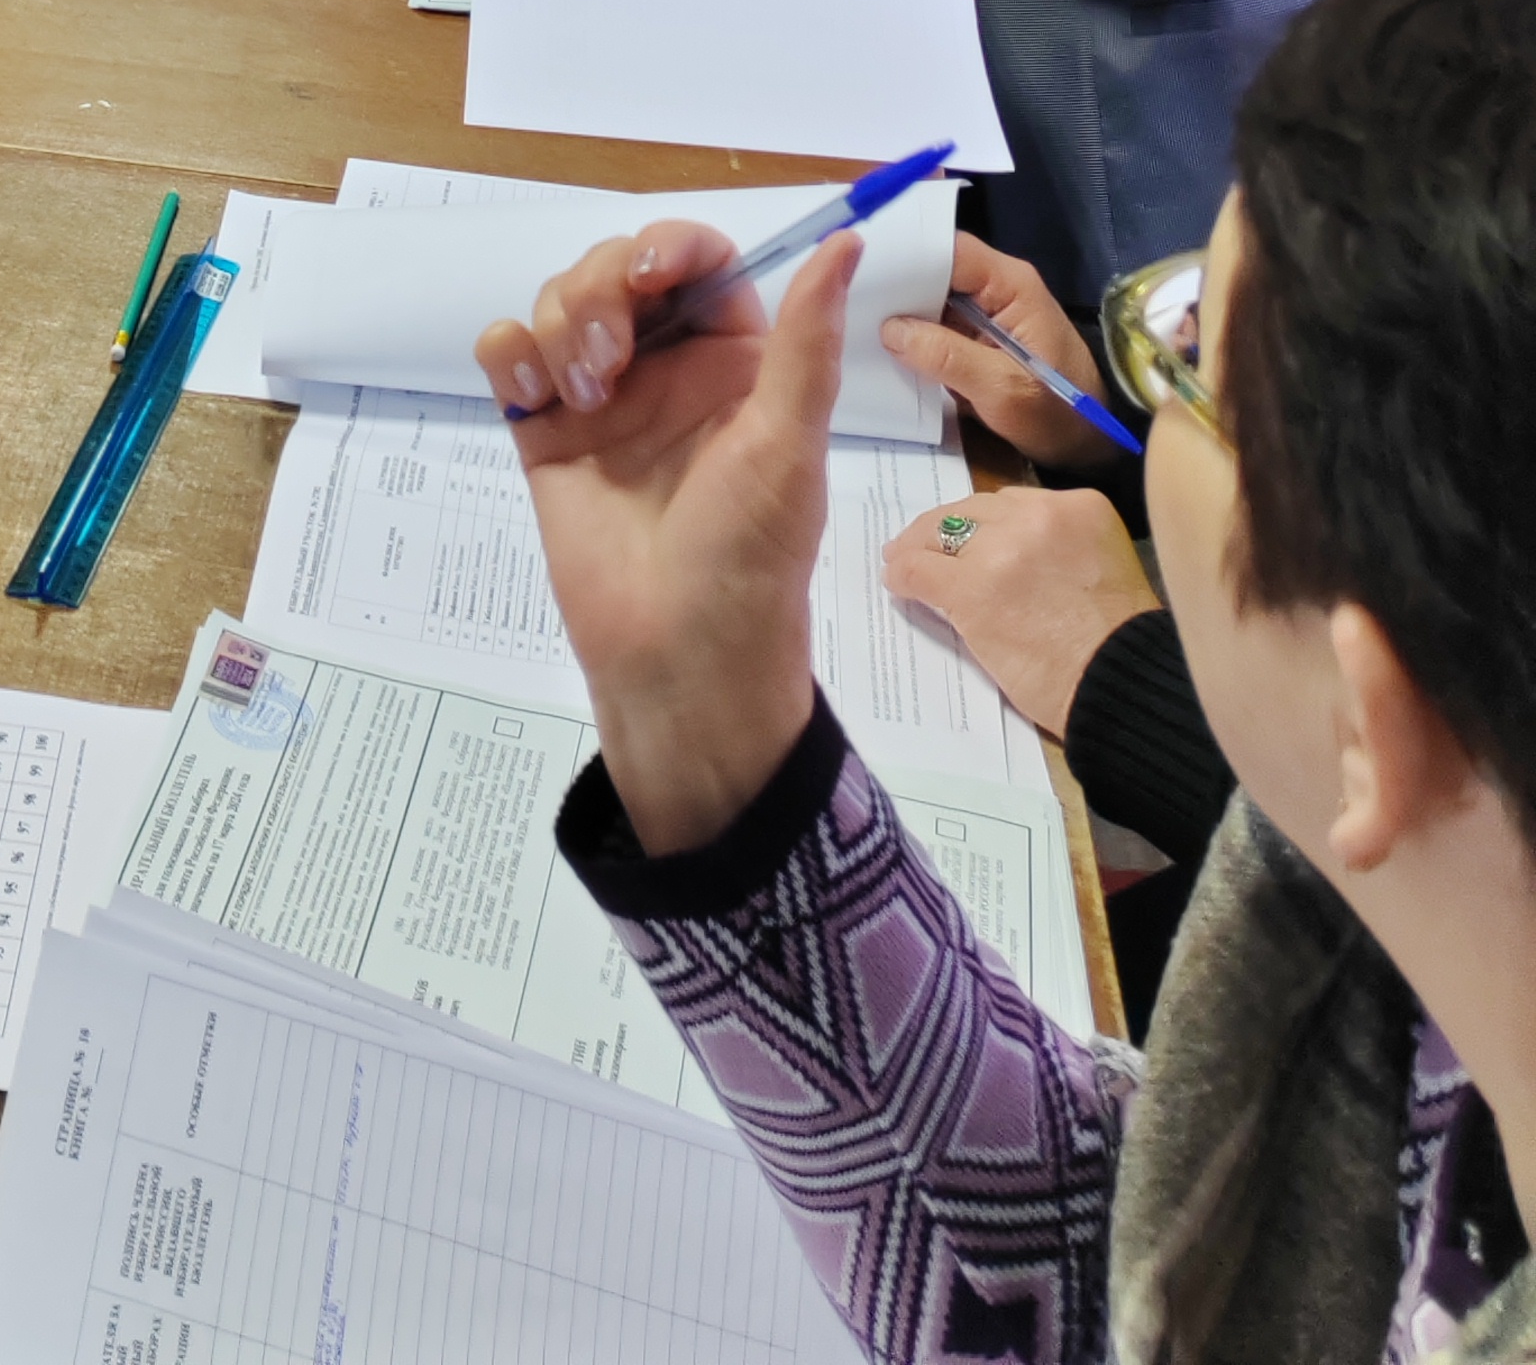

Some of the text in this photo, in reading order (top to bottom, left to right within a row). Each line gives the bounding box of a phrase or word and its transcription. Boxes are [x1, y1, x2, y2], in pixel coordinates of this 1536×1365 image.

[183, 815, 216, 869] Российской
[206, 766, 236, 815] Федерации,
[189, 778, 211, 816] выборах
[226, 791, 244, 813] 2024
[237, 773, 252, 793] года
[247, 826, 272, 876] ЗАПОЛНЕНИЯ
[266, 763, 295, 827] ИЗБИРАТЕЛЬНОГО
[10, 851, 25, 864] 96
[17, 820, 30, 834] 97
[129, 816, 171, 893] ИРАТЕЛЬНЫЙ
[160, 753, 198, 818] БЮЛЛЕТЕНЬ
[211, 838, 225, 851] 17
[219, 813, 236, 839] марта
[3, 881, 19, 894] 95
[54, 1060, 84, 1156] СТРАНИЦА
[73, 1050, 86, 1067] №
[185, 1011, 218, 1139] ОСОБЫЕ ОТМЕТКИ
[68, 1085, 93, 1161] КНИГА №
[119, 1162, 150, 1278] ПОДПИСЬ ЧЛЕНА
[133, 1165, 163, 1283] ИЗБИРАТЕЛЬНОЙ
[163, 1187, 187, 1278] ВЫДАВШЕГО
[174, 1176, 204, 1298] ИЗБИРАТЕЛЬНЫЙ
[190, 1198, 214, 1285] БЮЛЛЕТЕНЬ
[109, 1304, 121, 1319] ЗА
[145, 1317, 163, 1365] ЫБОРАХ
